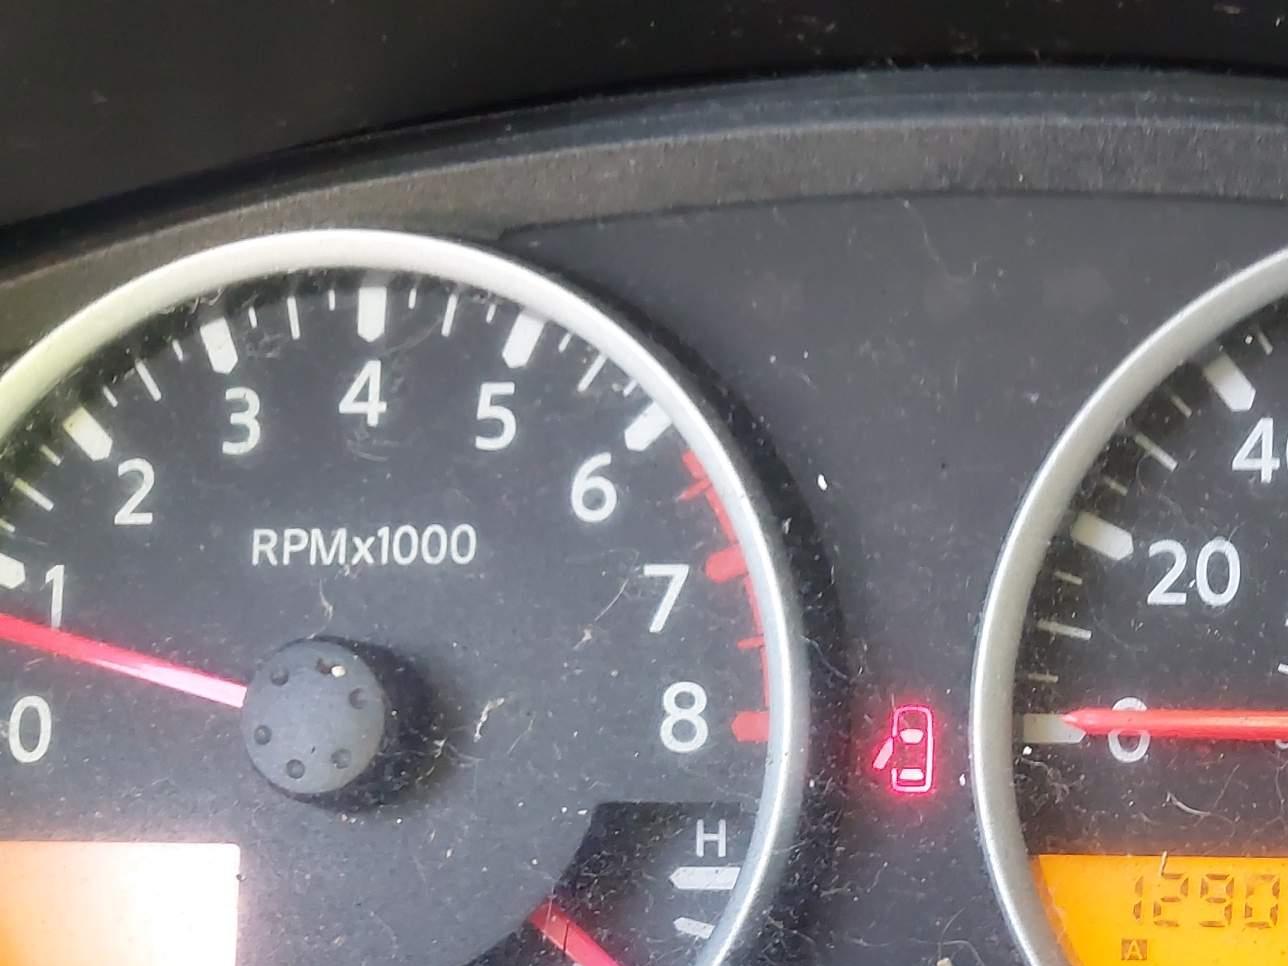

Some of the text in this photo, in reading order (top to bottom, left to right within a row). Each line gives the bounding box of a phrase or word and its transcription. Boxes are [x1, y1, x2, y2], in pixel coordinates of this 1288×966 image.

[221, 387, 261, 456] 3
[338, 358, 388, 427] 4
[475, 382, 518, 451] 5
[113, 459, 155, 526] 2
[570, 452, 618, 523] 6
[251, 524, 478, 567] RPMx1000
[1147, 537, 1241, 607] 20
[45, 564, 65, 629] 1
[644, 564, 690, 633] 7
[9, 695, 51, 764] 0
[660, 682, 709, 753] 8
[695, 818, 728, 858] H
